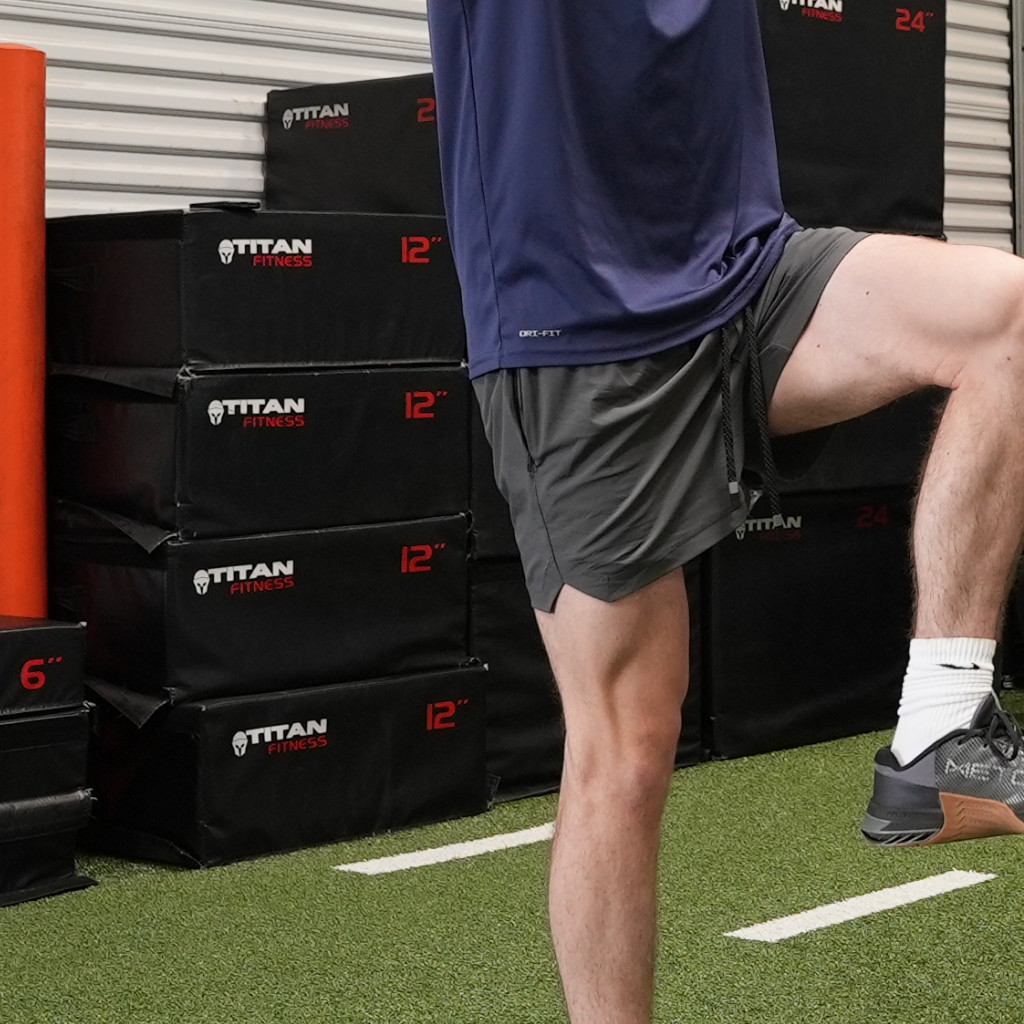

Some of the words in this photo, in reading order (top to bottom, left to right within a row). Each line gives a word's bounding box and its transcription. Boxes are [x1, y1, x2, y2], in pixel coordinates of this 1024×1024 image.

[801, 8, 843, 23] FITNESS
[292, 103, 349, 121] TITAN
[304, 117, 350, 129] FITNESS
[232, 239, 313, 254] TITAN
[401, 236, 442, 263] 12"
[253, 255, 313, 267] FITNESS
[222, 398, 305, 416] TITAN
[405, 391, 448, 419] 12"
[243, 414, 305, 427] FITNESS
[745, 516, 802, 532] TITAN
[401, 544, 446, 574] 12"
[207, 560, 294, 580] TITAN
[229, 574, 295, 595] FITNESS
[20, 657, 63, 690] 6"
[426, 700, 469, 731] 12"
[245, 718, 328, 745] TITAN
[267, 735, 328, 754] FITNESS
